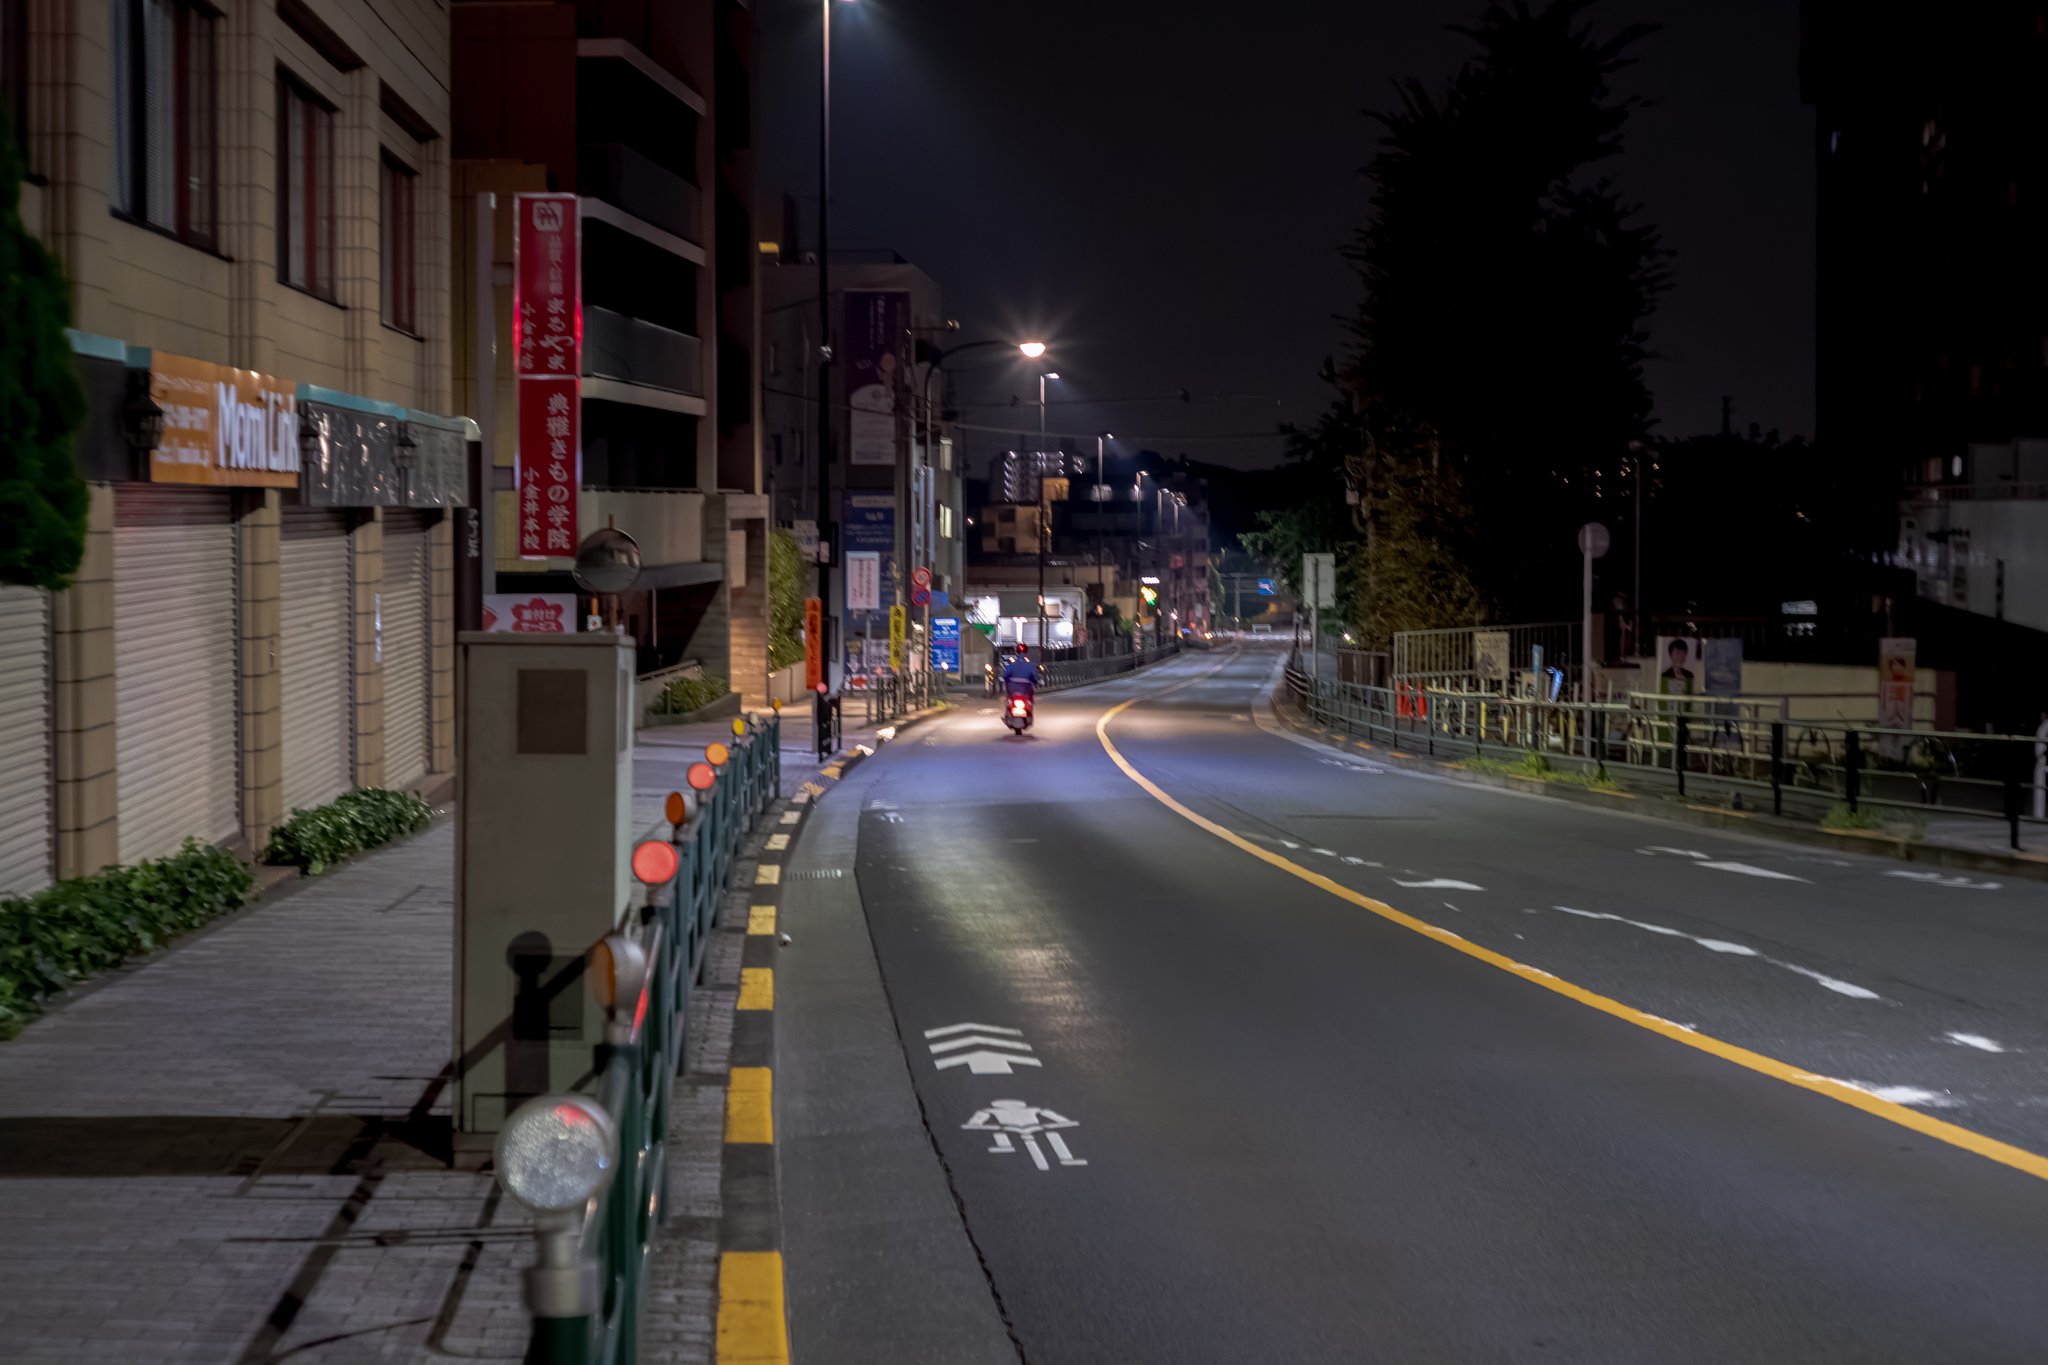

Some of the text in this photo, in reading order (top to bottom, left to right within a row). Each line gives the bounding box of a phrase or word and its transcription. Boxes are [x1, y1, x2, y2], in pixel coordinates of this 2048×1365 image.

[522, 466, 541, 550] 小金井本校
[546, 391, 571, 550] 典雅きもの学院
